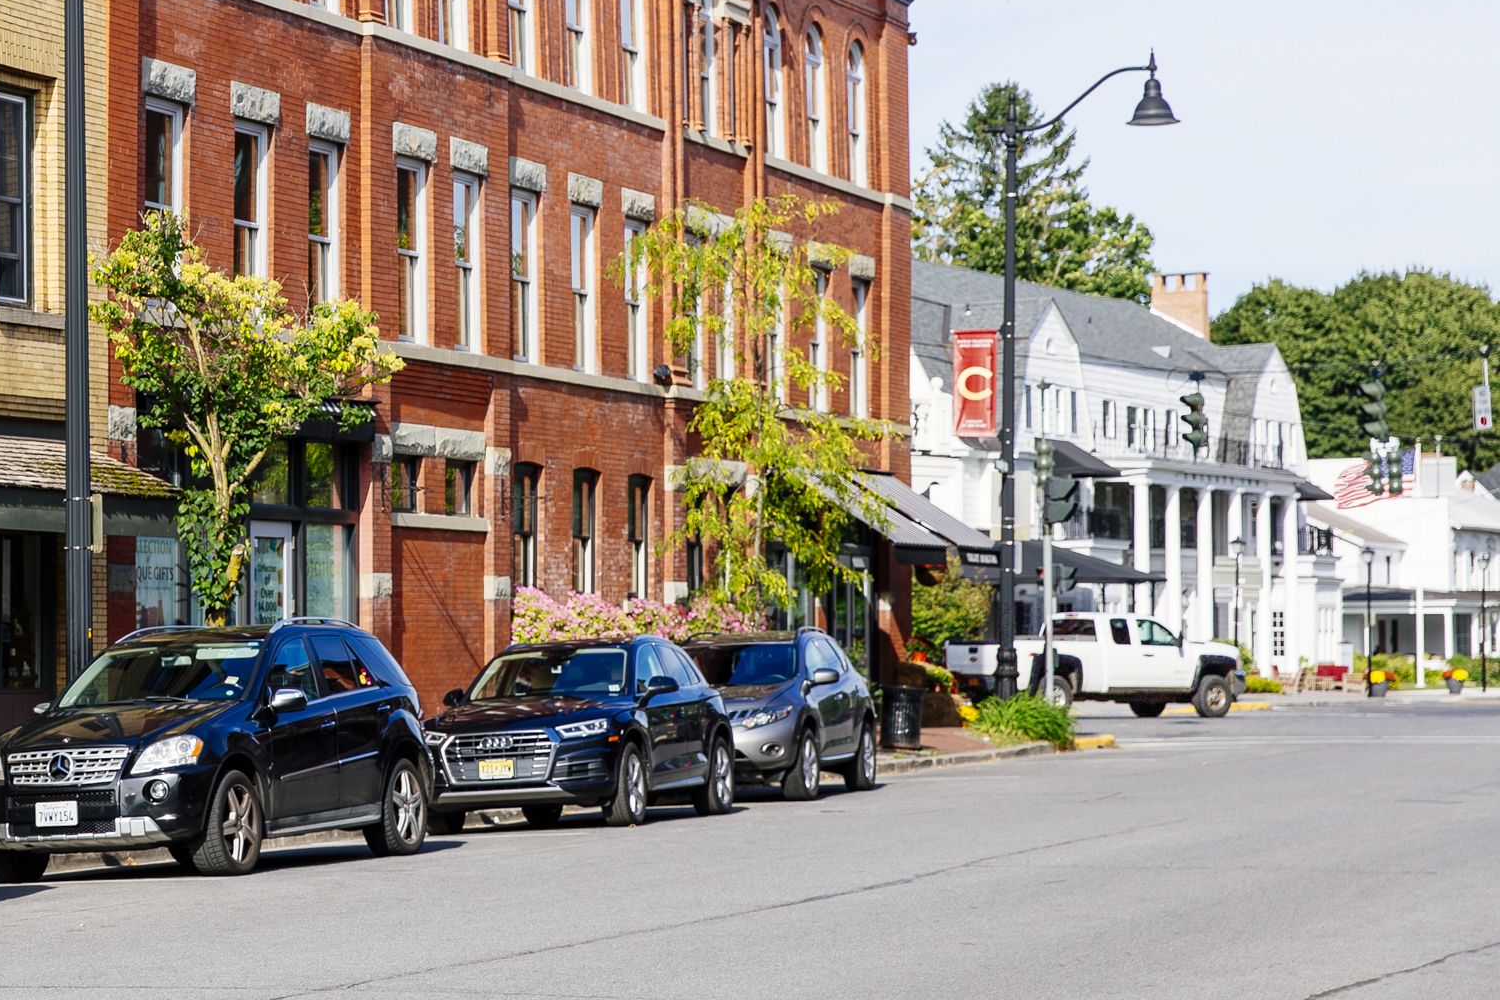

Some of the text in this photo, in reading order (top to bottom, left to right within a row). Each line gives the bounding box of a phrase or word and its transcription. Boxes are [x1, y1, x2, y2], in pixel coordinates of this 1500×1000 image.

[957, 366, 993, 401] C
[153, 566, 174, 581] GIFTS
[260, 588, 274, 599] Over
